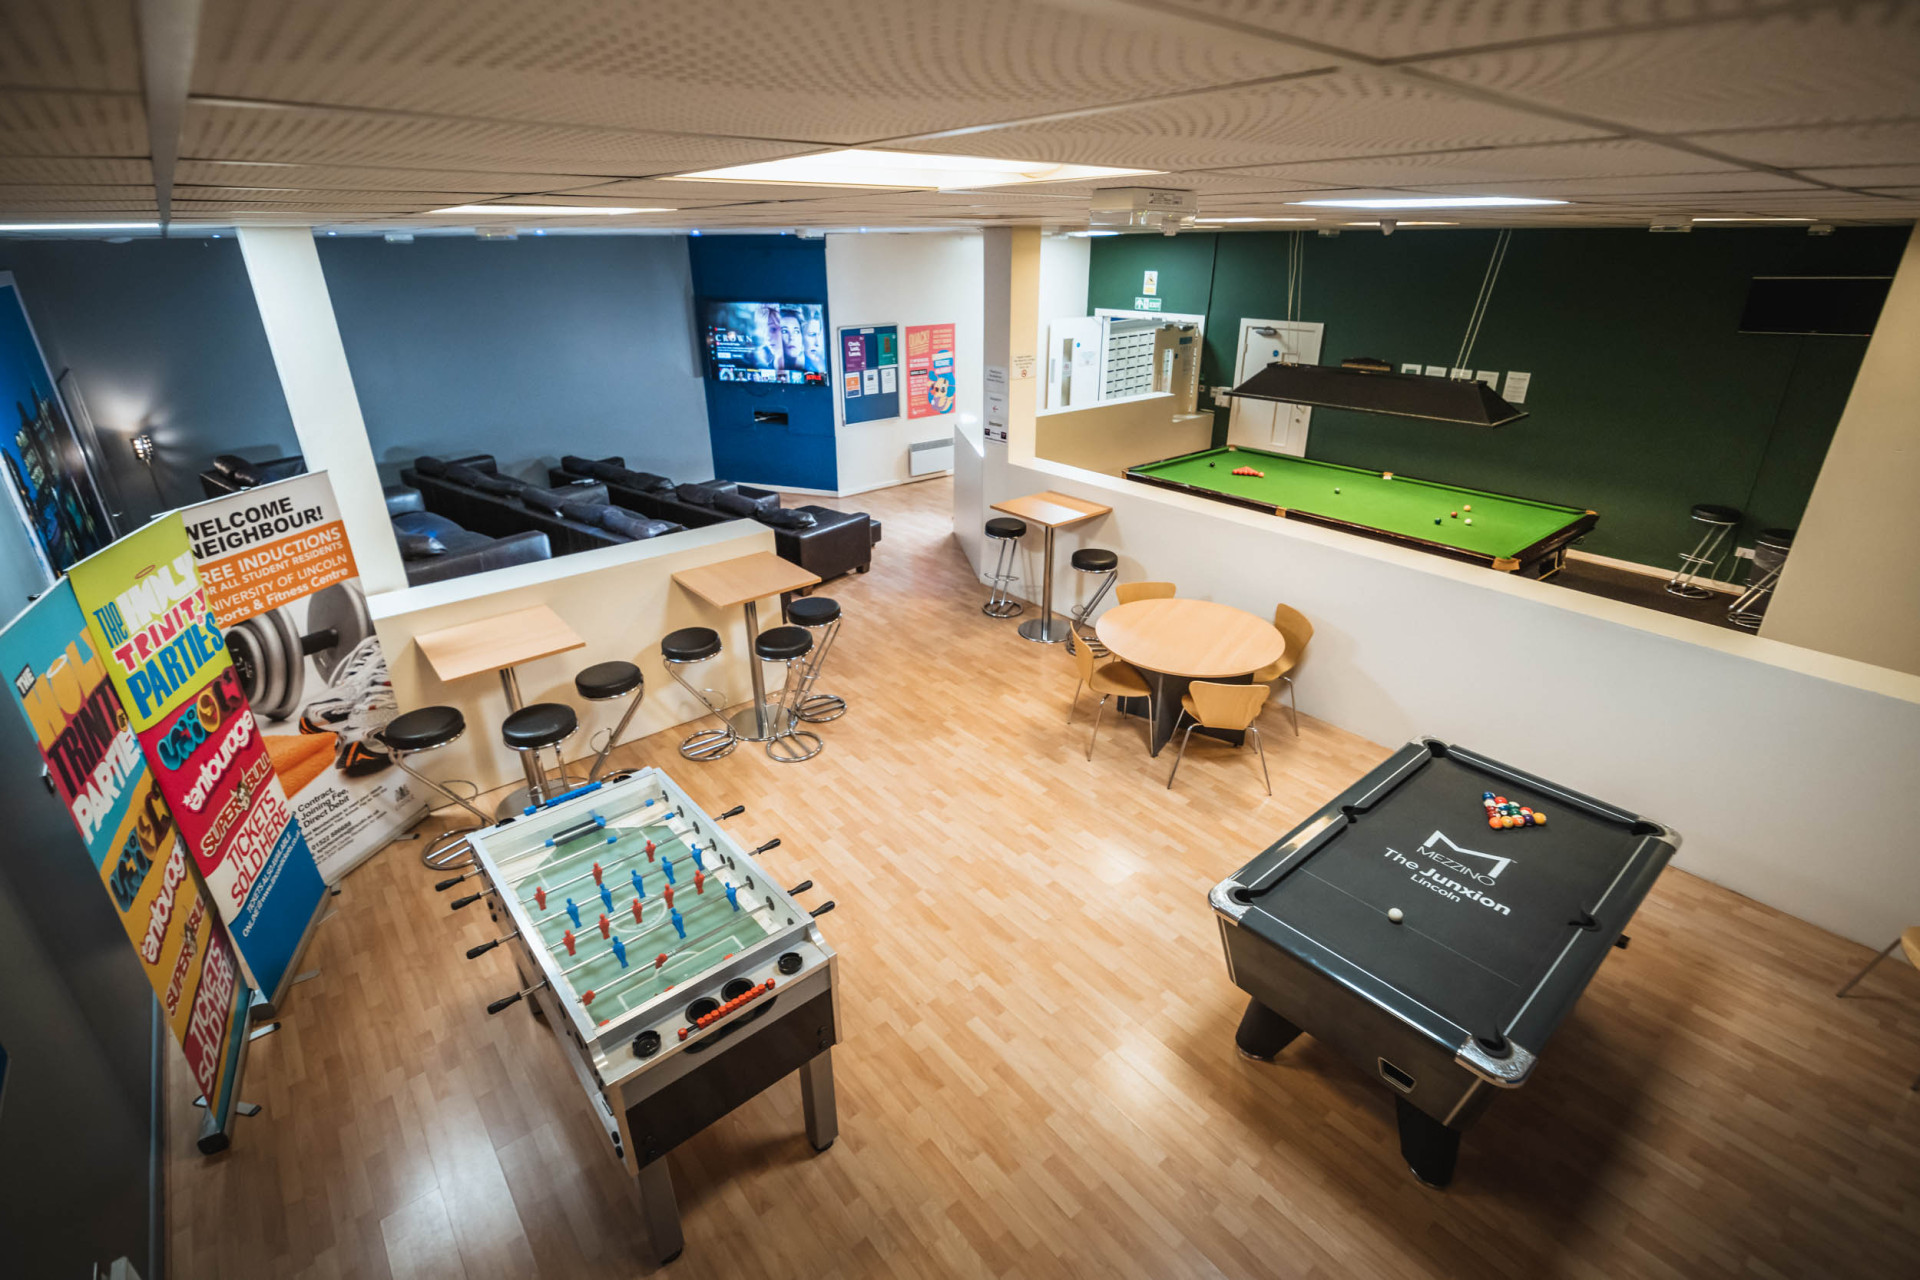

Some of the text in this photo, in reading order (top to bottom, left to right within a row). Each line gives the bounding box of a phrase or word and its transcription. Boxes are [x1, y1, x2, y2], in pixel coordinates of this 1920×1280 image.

[715, 333, 752, 343] CROWN
[185, 497, 294, 541] WELCOME
[200, 527, 341, 585] REE INDUCTIONS
[211, 581, 274, 611] NIVERSITY
[277, 573, 295, 588] OF
[297, 554, 348, 580] LINCOLN
[220, 578, 241, 591] ALL
[241, 561, 290, 584] STUDENT
[292, 541, 344, 565] RESIDENTS
[217, 606, 251, 625] ports
[253, 598, 265, 611] &
[265, 582, 309, 606] Fitness
[311, 568, 348, 588] Centre
[113, 586, 207, 673] TRINITY
[125, 611, 225, 720] PARTIES
[72, 727, 140, 845] PARTIE
[301, 799, 331, 821] Joining
[303, 809, 328, 828] Direct
[329, 795, 350, 812] Debit
[227, 789, 277, 872] TICKETS
[231, 848, 263, 908] SOLD
[260, 801, 290, 857] HERE
[1383, 847, 1512, 917] The Junxion
[1410, 874, 1461, 903] Lincoln
[1416, 846, 1497, 887] MEZZINO
[142, 836, 186, 963] entourag
[190, 938, 223, 1045] TICKETS
[199, 1012, 223, 1095] SOLD
